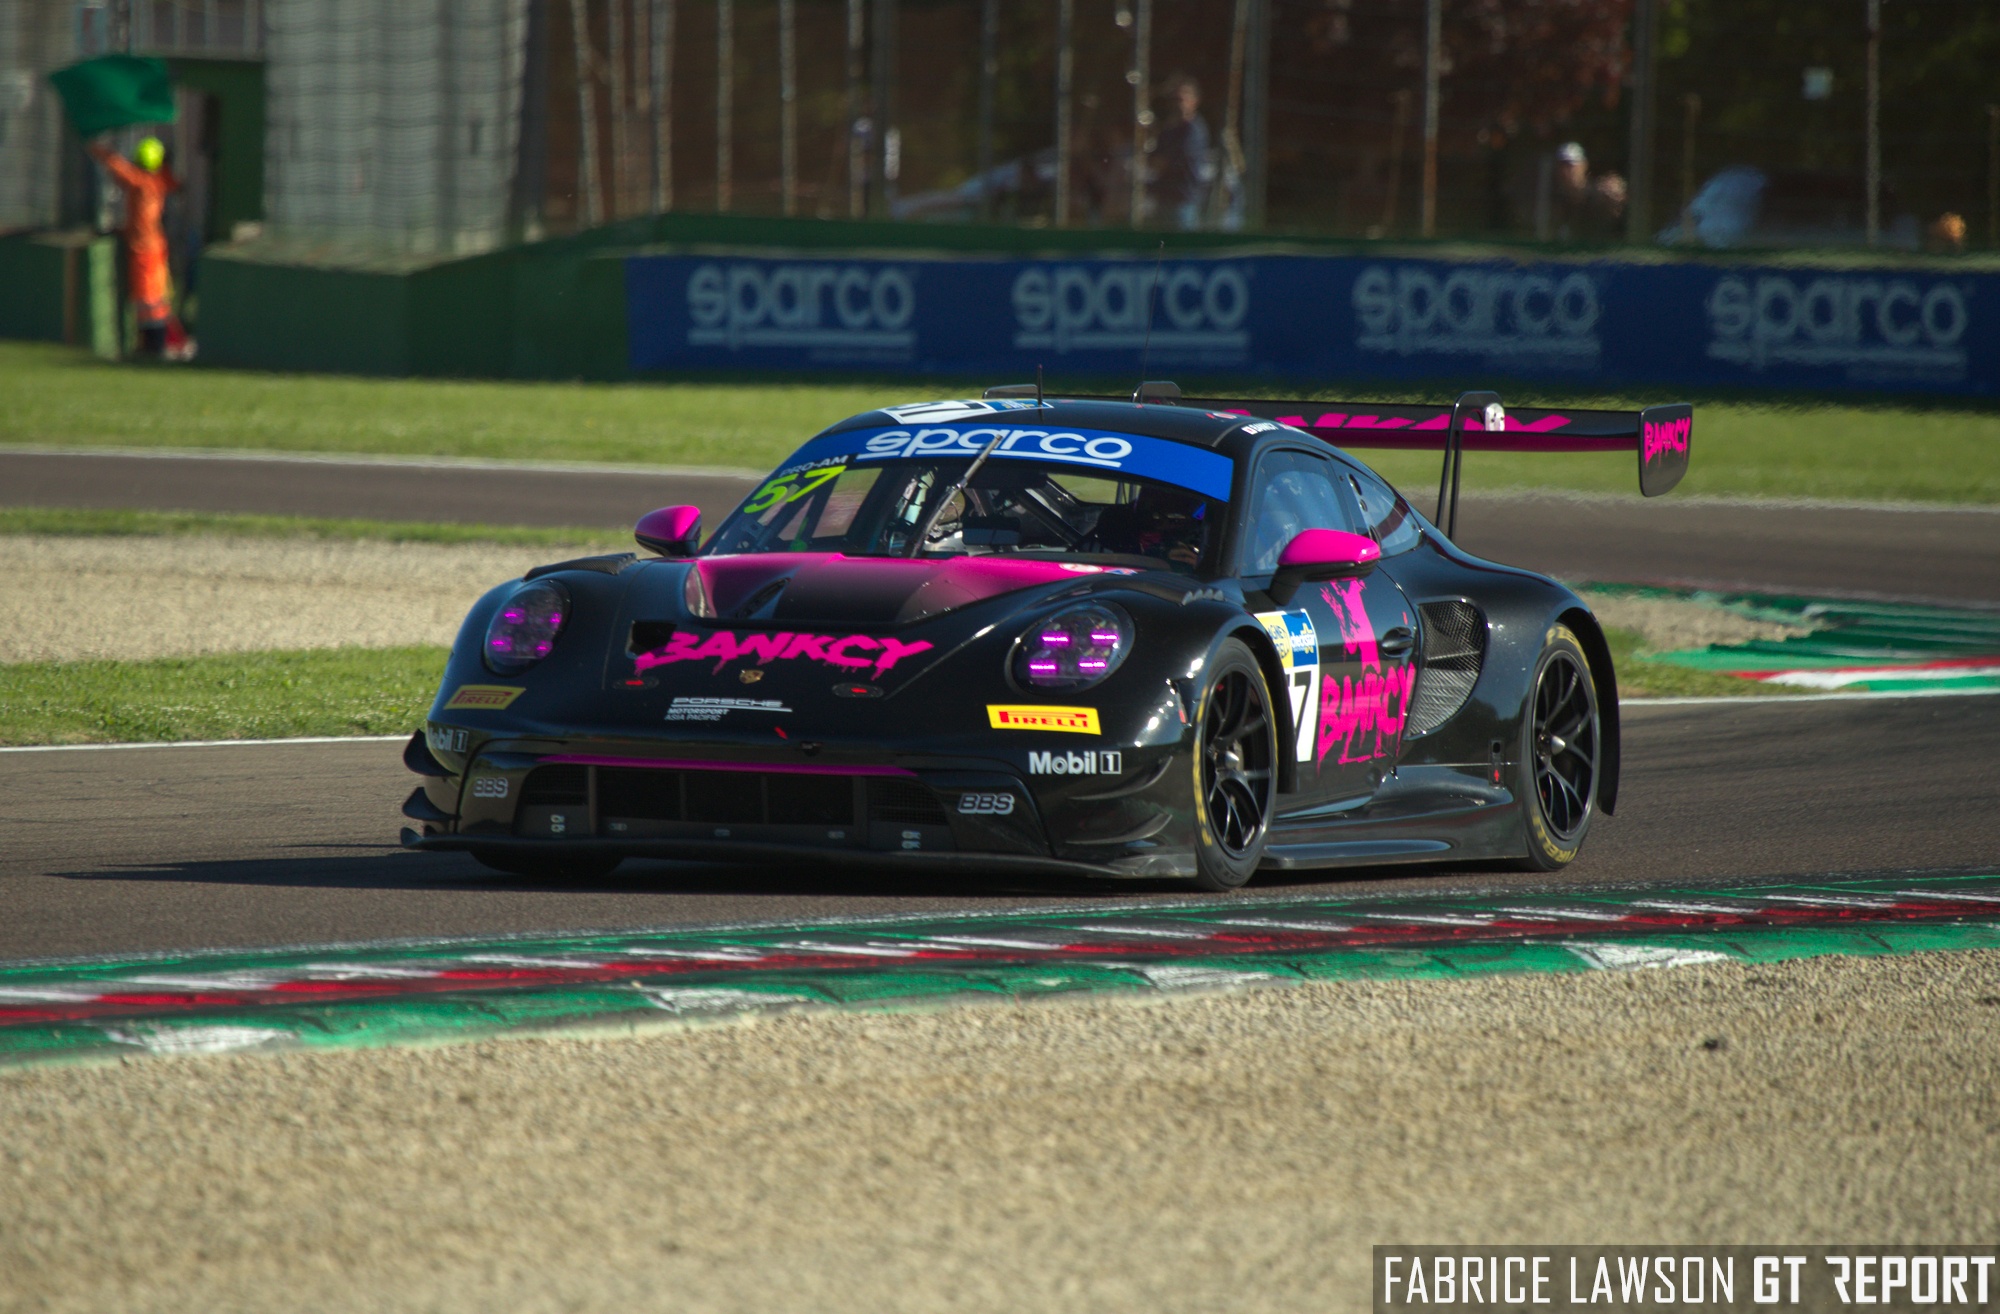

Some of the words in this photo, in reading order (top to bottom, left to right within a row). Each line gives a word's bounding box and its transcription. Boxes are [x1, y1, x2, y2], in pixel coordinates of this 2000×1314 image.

[687, 265, 916, 348] sparco
[1012, 265, 1249, 352] sparco
[1353, 265, 1601, 355] sparco
[1707, 275, 1967, 368] sparco
[861, 427, 1133, 466] sparco
[1643, 416, 1692, 466] BANKCY
[779, 455, 849, 478] PRO-AM
[743, 465, 848, 514] 57
[634, 631, 934, 678] BANKCY
[452, 688, 513, 705] PIRELLI
[667, 708, 730, 716] MOTORSPORT
[671, 697, 785, 708] PORSCHE
[1286, 670, 1312, 741] 7
[686, 714, 723, 722] PACIFIC
[999, 710, 1089, 729] PIRELLI
[1317, 662, 1416, 764] BANKCY
[456, 731, 466, 751] 1
[1029, 751, 1097, 775] Mobil
[1103, 753, 1119, 773] 1
[473, 776, 509, 798] BBS
[957, 792, 1015, 815] BBS
